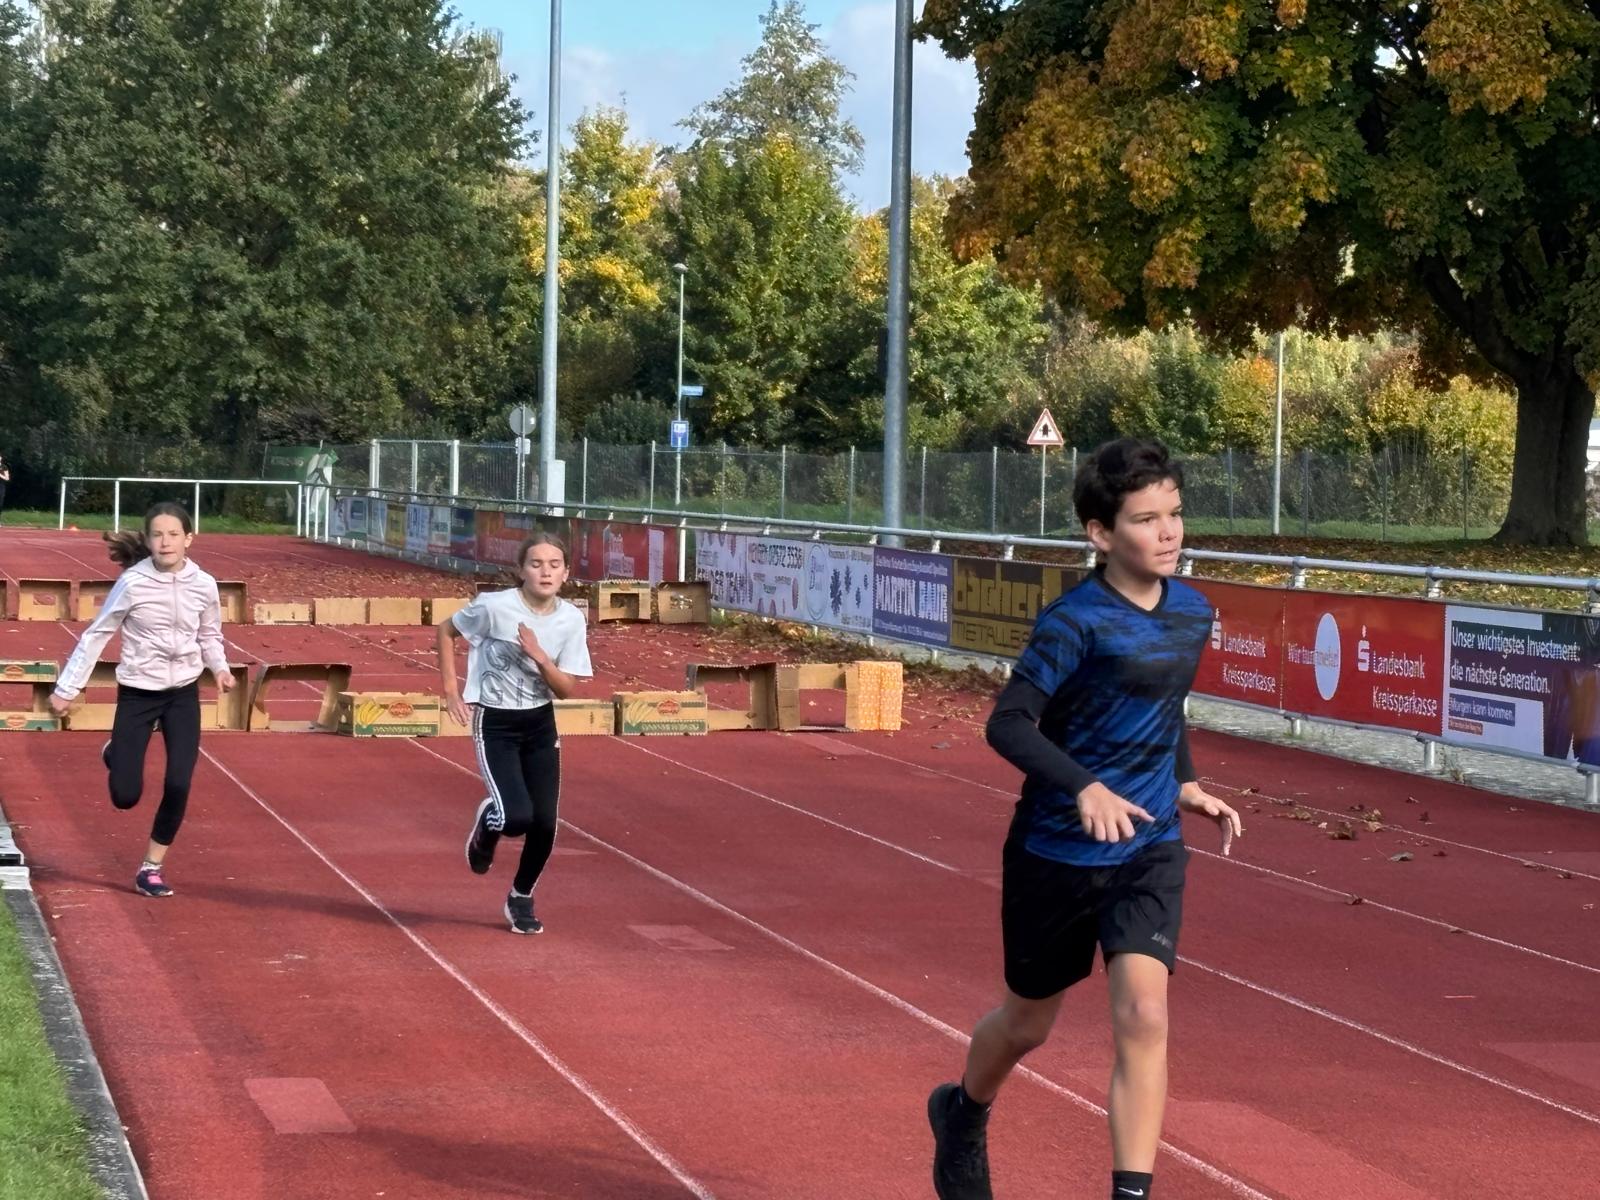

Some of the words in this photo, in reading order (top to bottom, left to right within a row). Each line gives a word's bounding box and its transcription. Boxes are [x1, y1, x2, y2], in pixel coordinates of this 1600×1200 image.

[875, 573, 917, 617] MARTIN
[1223, 631, 1266, 659] Landesbank
[1451, 626, 1474, 648] Unser
[1477, 629, 1525, 659] wichtigstes
[1527, 634, 1581, 662] Investment:
[1222, 662, 1276, 693] Kreissparkasse
[1372, 651, 1426, 680] Landesbank
[1451, 658, 1464, 682] die
[1465, 662, 1497, 687] nächste
[1500, 666, 1551, 693] Generation.
[1372, 685, 1438, 717] Kreissparkasse
